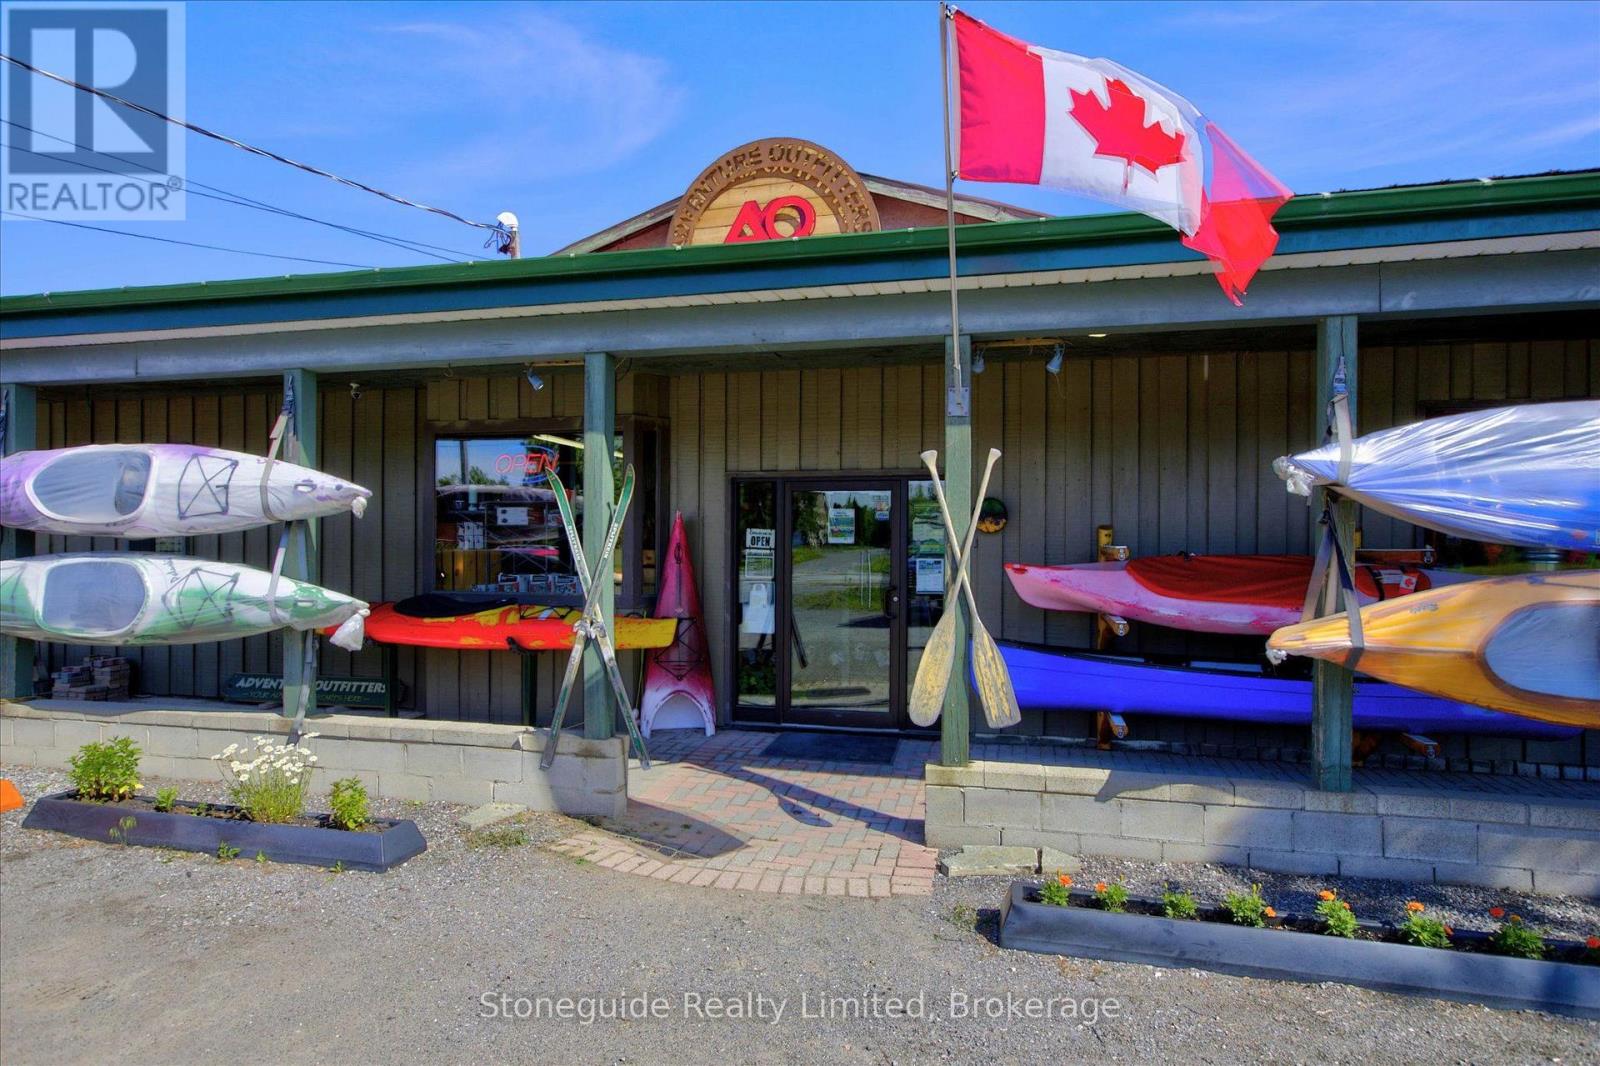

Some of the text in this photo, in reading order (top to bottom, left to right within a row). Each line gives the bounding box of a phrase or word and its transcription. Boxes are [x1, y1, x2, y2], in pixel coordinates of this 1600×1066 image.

[723, 195, 817, 244] AO
[495, 453, 560, 475] OPEN
[750, 535, 771, 547] OPEN
[235, 677, 386, 693] ADVENT OUTFITTERS
